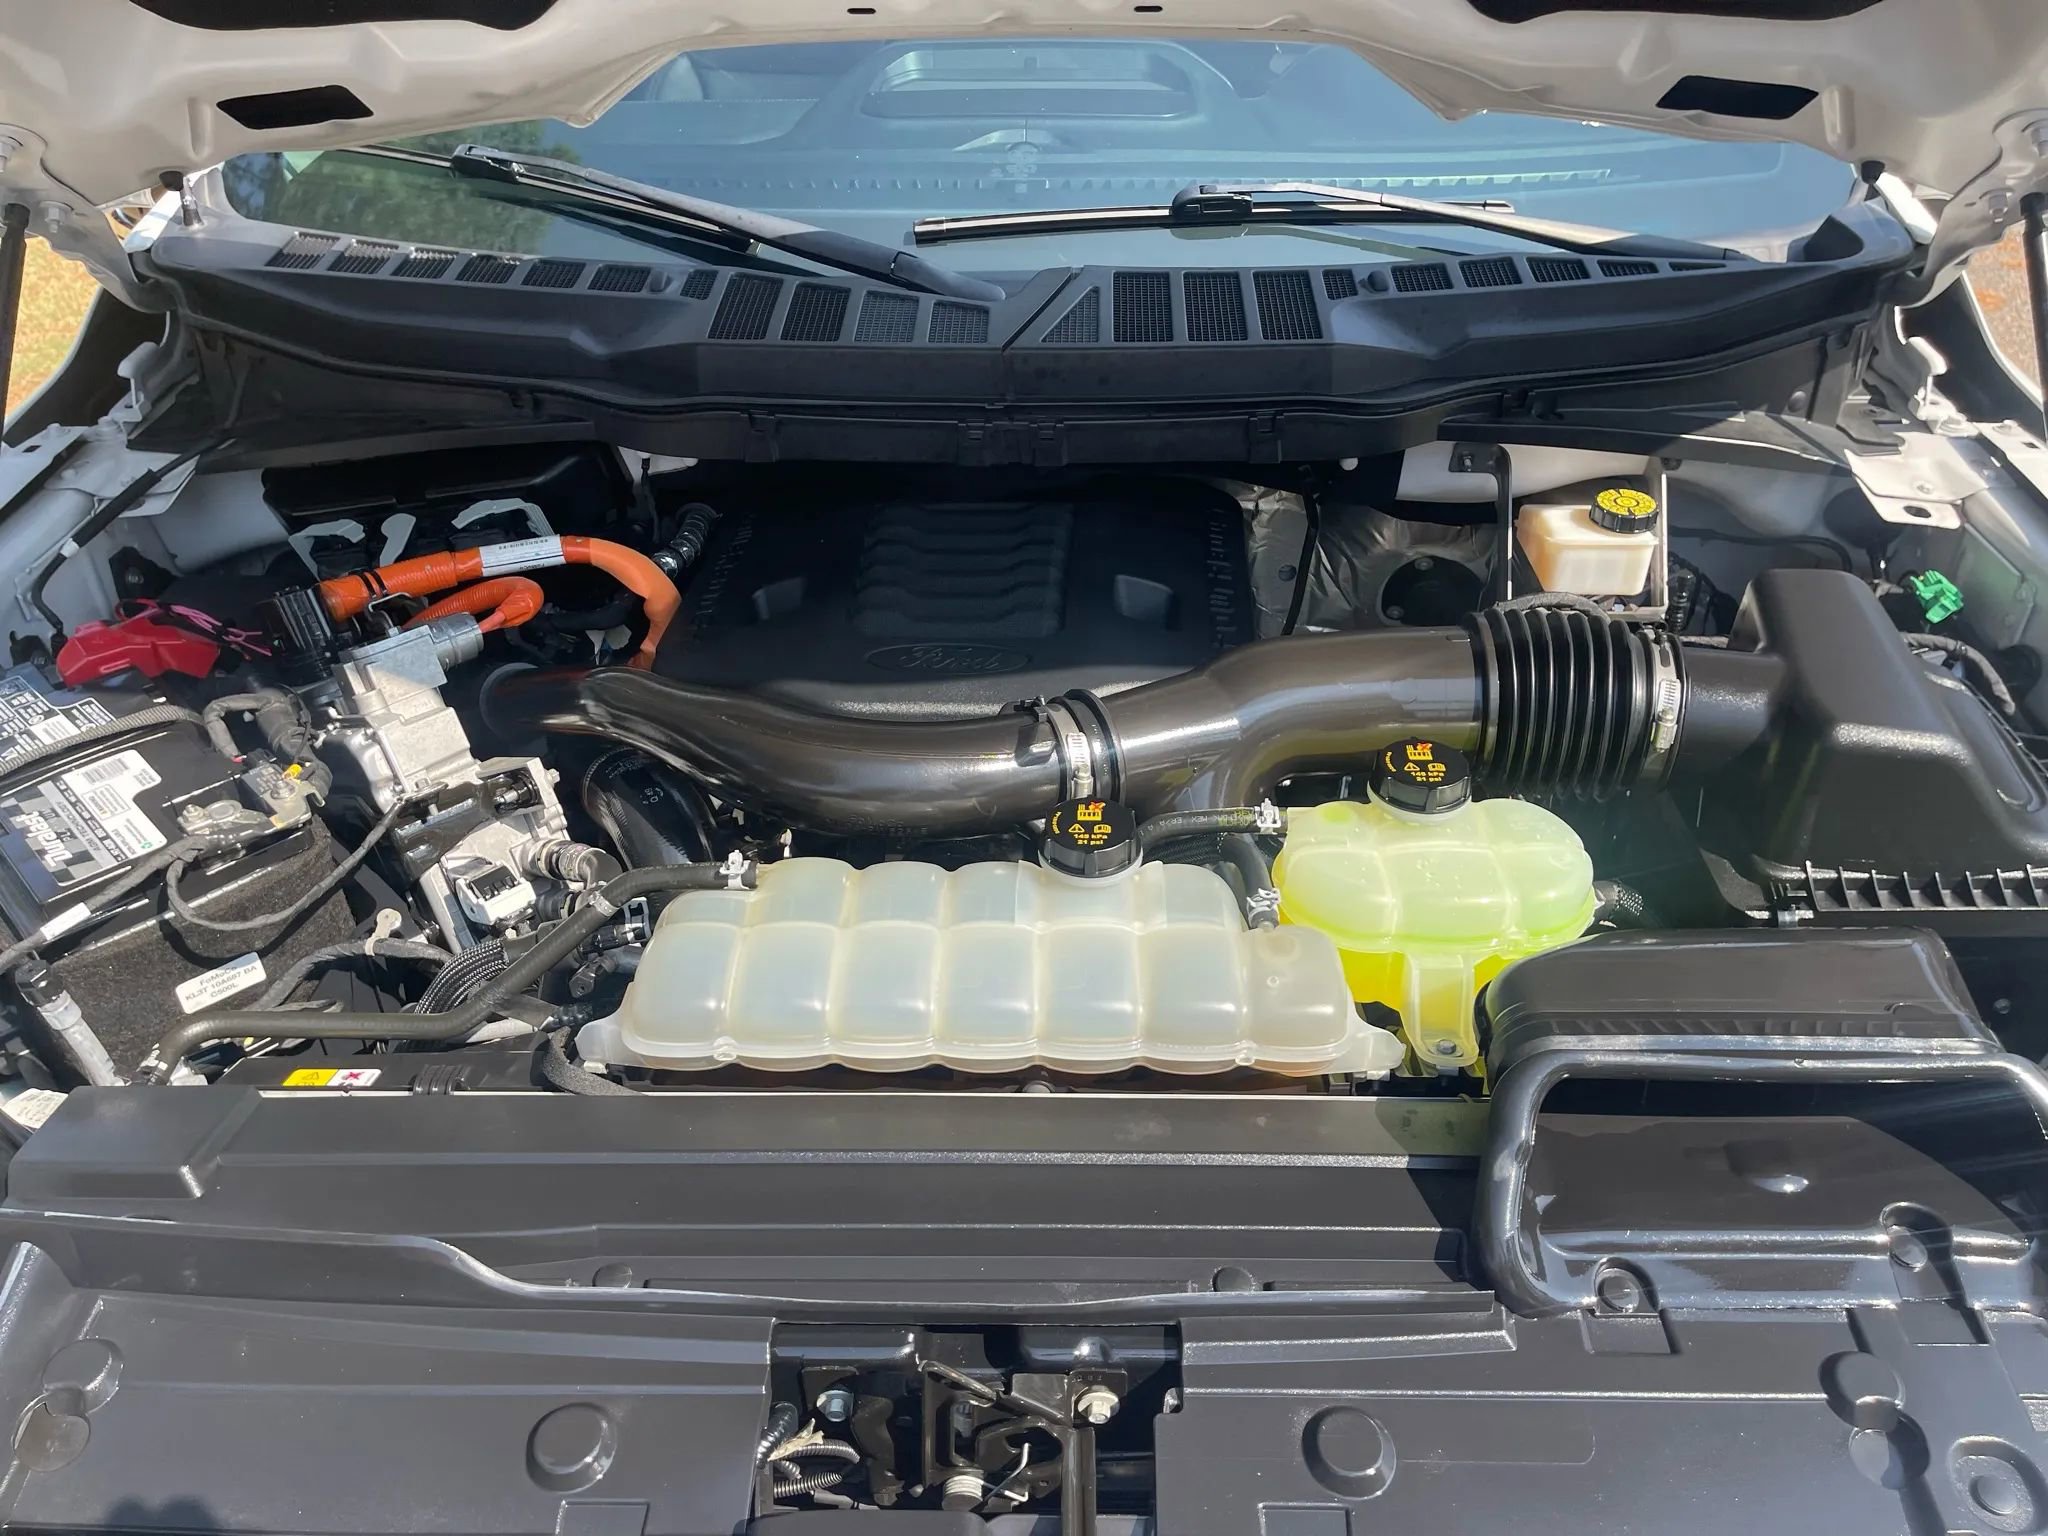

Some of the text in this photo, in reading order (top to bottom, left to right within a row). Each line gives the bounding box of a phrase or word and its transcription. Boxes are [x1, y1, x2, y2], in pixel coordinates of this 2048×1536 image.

[899, 645, 1002, 670] Ford
[17, 811, 73, 867] Duralast
[200, 967, 237, 986] FoMoCo
